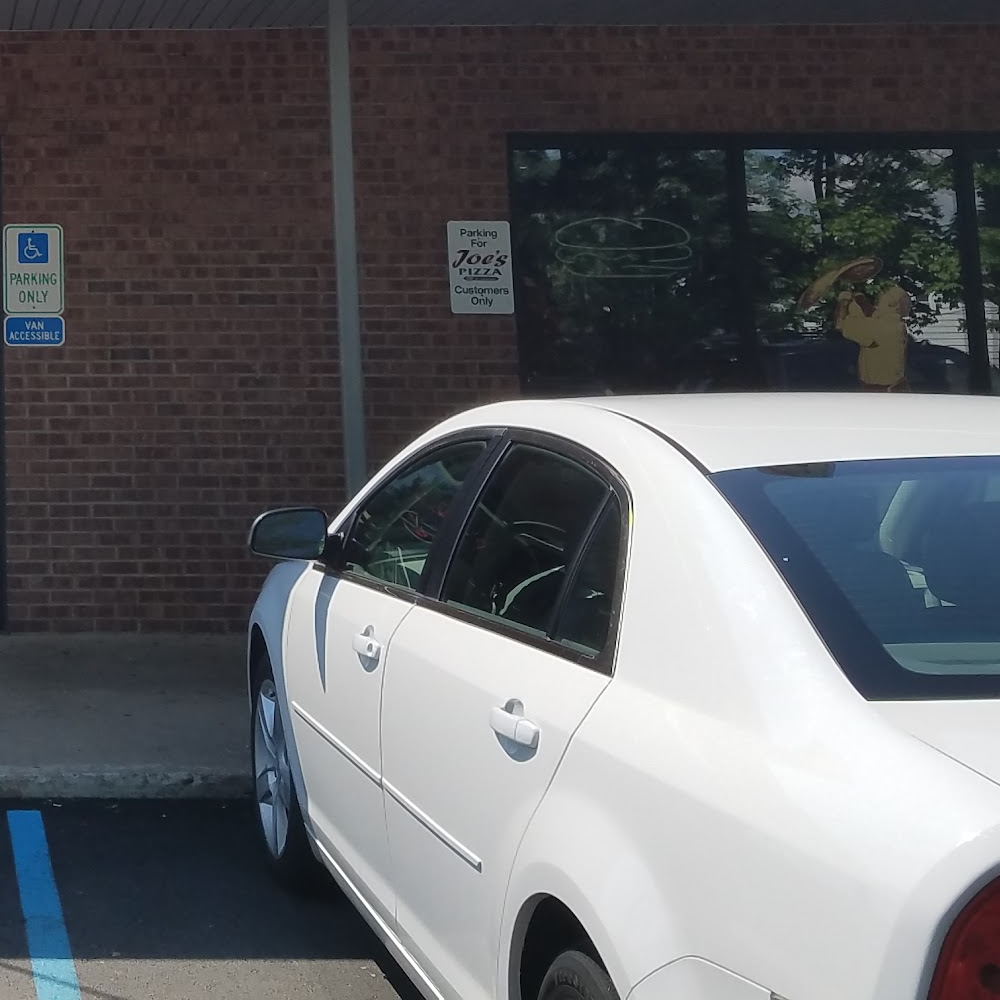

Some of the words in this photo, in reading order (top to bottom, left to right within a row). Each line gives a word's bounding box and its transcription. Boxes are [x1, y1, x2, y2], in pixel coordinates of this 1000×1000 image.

[460, 229, 497, 239] Parking
[471, 239, 487, 247] For
[452, 250, 508, 268] Joe's
[459, 268, 502, 276] PIZZA
[10, 273, 57, 285] PARKING
[454, 285, 509, 295] Customers
[19, 291, 48, 303] ONLY
[471, 296, 493, 307] Only
[24, 320, 44, 330] VAN
[9, 331, 60, 341] ACCESSIBLE
